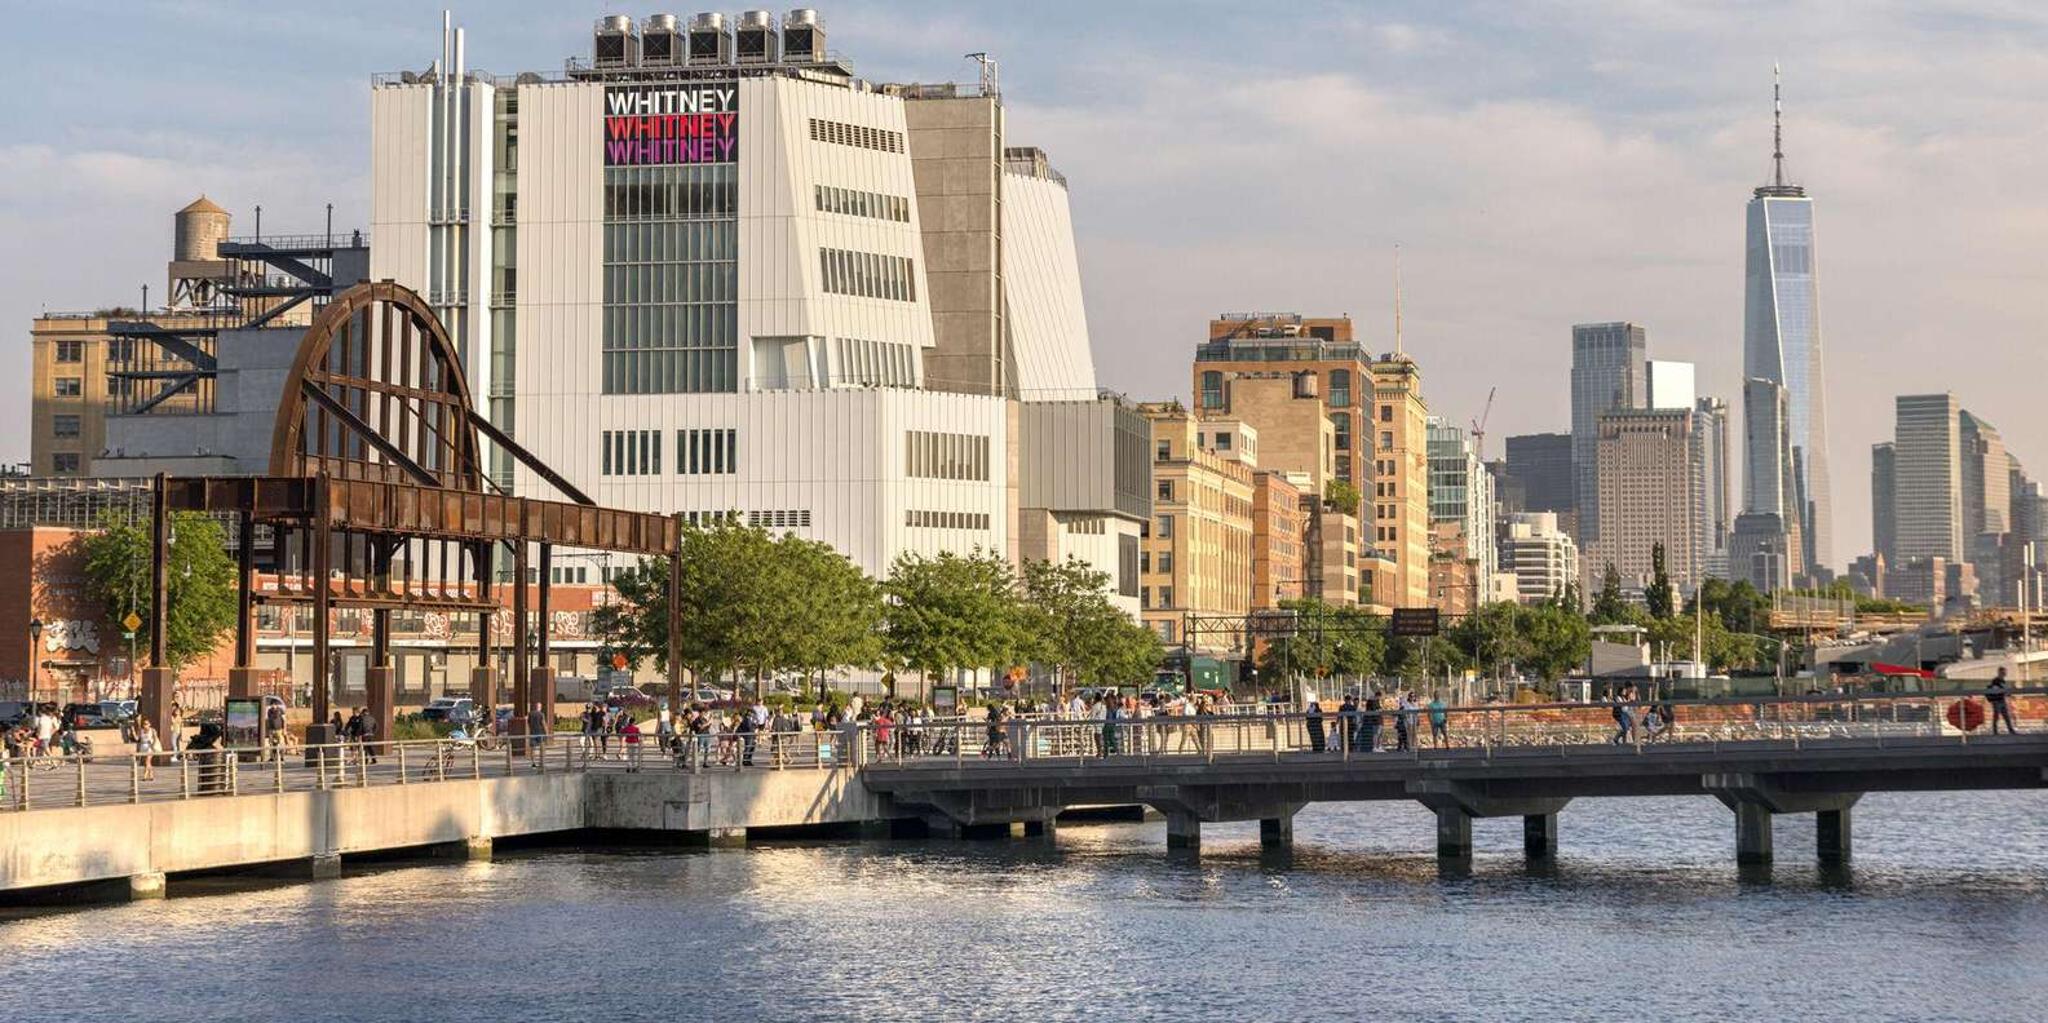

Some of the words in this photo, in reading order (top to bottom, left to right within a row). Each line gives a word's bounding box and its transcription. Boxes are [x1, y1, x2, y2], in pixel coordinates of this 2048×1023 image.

[608, 90, 734, 114] WHITNEY
[607, 114, 735, 139] WHITNEY
[608, 138, 734, 163] WHITNEY
